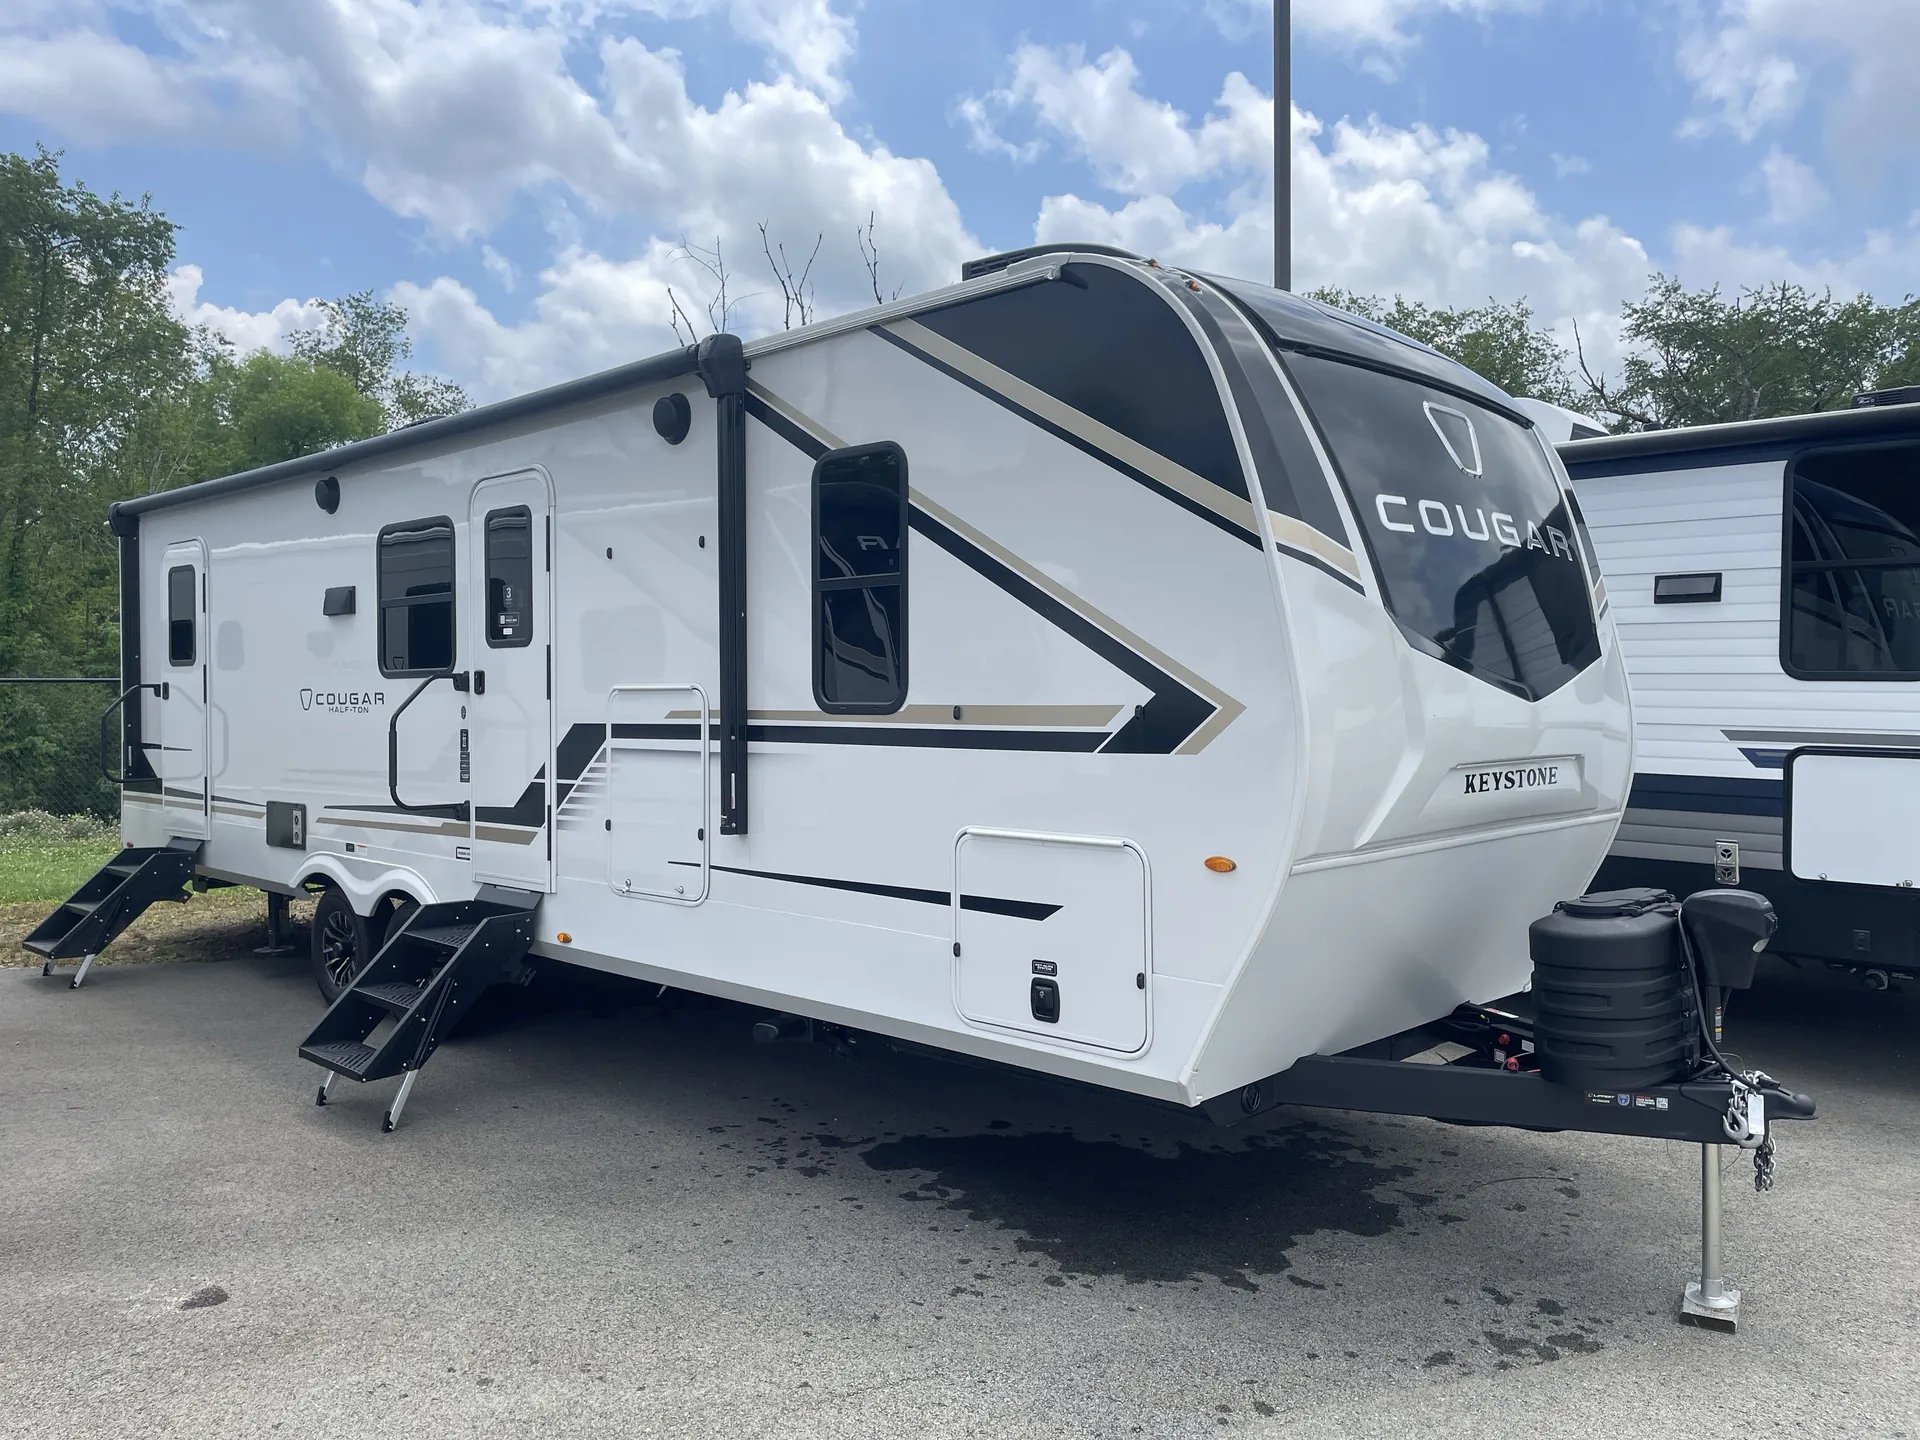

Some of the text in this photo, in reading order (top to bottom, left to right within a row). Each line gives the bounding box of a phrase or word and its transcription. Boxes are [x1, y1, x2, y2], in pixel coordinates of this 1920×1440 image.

[1375, 493, 1573, 562] COUGAR
[506, 587, 512, 599] 3
[316, 692, 385, 705] COUGAR
[328, 706, 370, 714] HALF-TON
[1464, 766, 1558, 794] KEYSTONE
